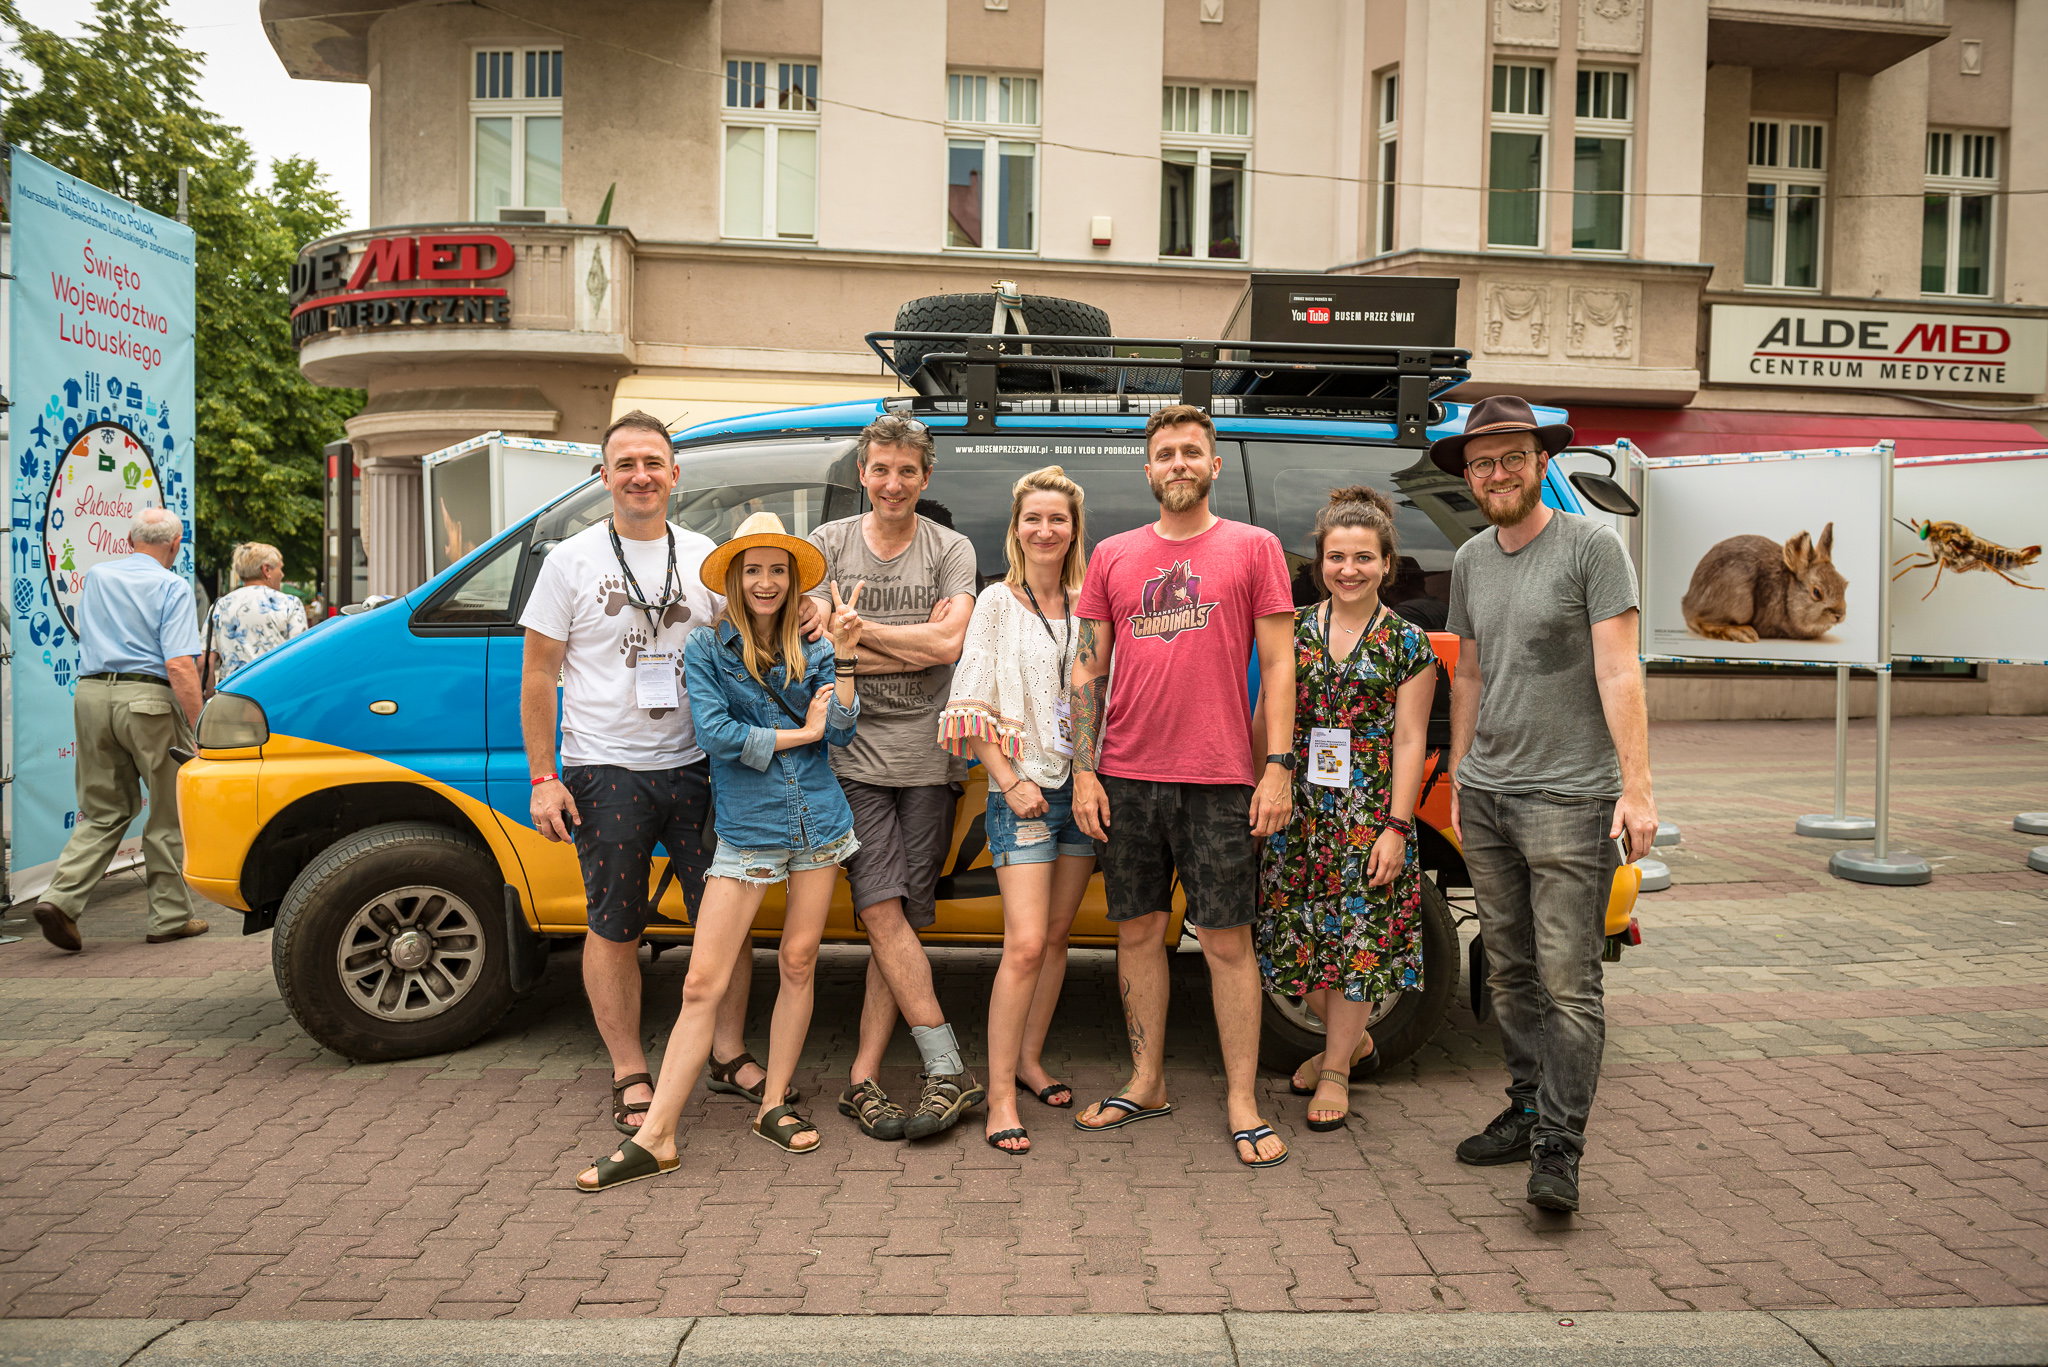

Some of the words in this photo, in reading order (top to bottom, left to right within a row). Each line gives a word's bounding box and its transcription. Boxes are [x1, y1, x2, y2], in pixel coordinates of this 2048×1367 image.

[18, 184, 59, 211] Marszałek
[60, 202, 108, 232] Województwa
[108, 223, 148, 249] Lubuskiego
[149, 242, 180, 261] zaprasza
[56, 181, 98, 213] Elżbieta
[101, 203, 126, 225] Anna
[127, 214, 158, 240] Polak,
[83, 238, 141, 290] Święto
[344, 235, 515, 290] MED
[51, 271, 168, 334] Województwa
[335, 296, 511, 327] MEDYCZNE
[1334, 311, 1362, 321] BUSEM
[1364, 311, 1388, 322] PRZEZ
[1390, 310, 1415, 323] ŚWIAT
[60, 313, 162, 370] Lubuskiego
[1757, 317, 1889, 350] ALDE
[1894, 323, 2011, 355] MED
[1750, 357, 1863, 379] CENTRUM
[1880, 362, 2006, 383] MEDYCZNE
[1264, 406, 1336, 415] CRYSTAL
[1338, 408, 1372, 416] LITE
[955, 445, 1049, 455] www.BUSEMPRZEZSWIAT.pl
[1054, 445, 1073, 454] BLOG
[1078, 446, 1096, 455] VLOG
[1097, 446, 1102, 455] O
[74, 485, 133, 519] Lubuskie
[838, 585, 936, 612] ARDWARE
[1148, 603, 1194, 617] TRANSFINITE
[1131, 605, 1211, 636] CARDINALS
